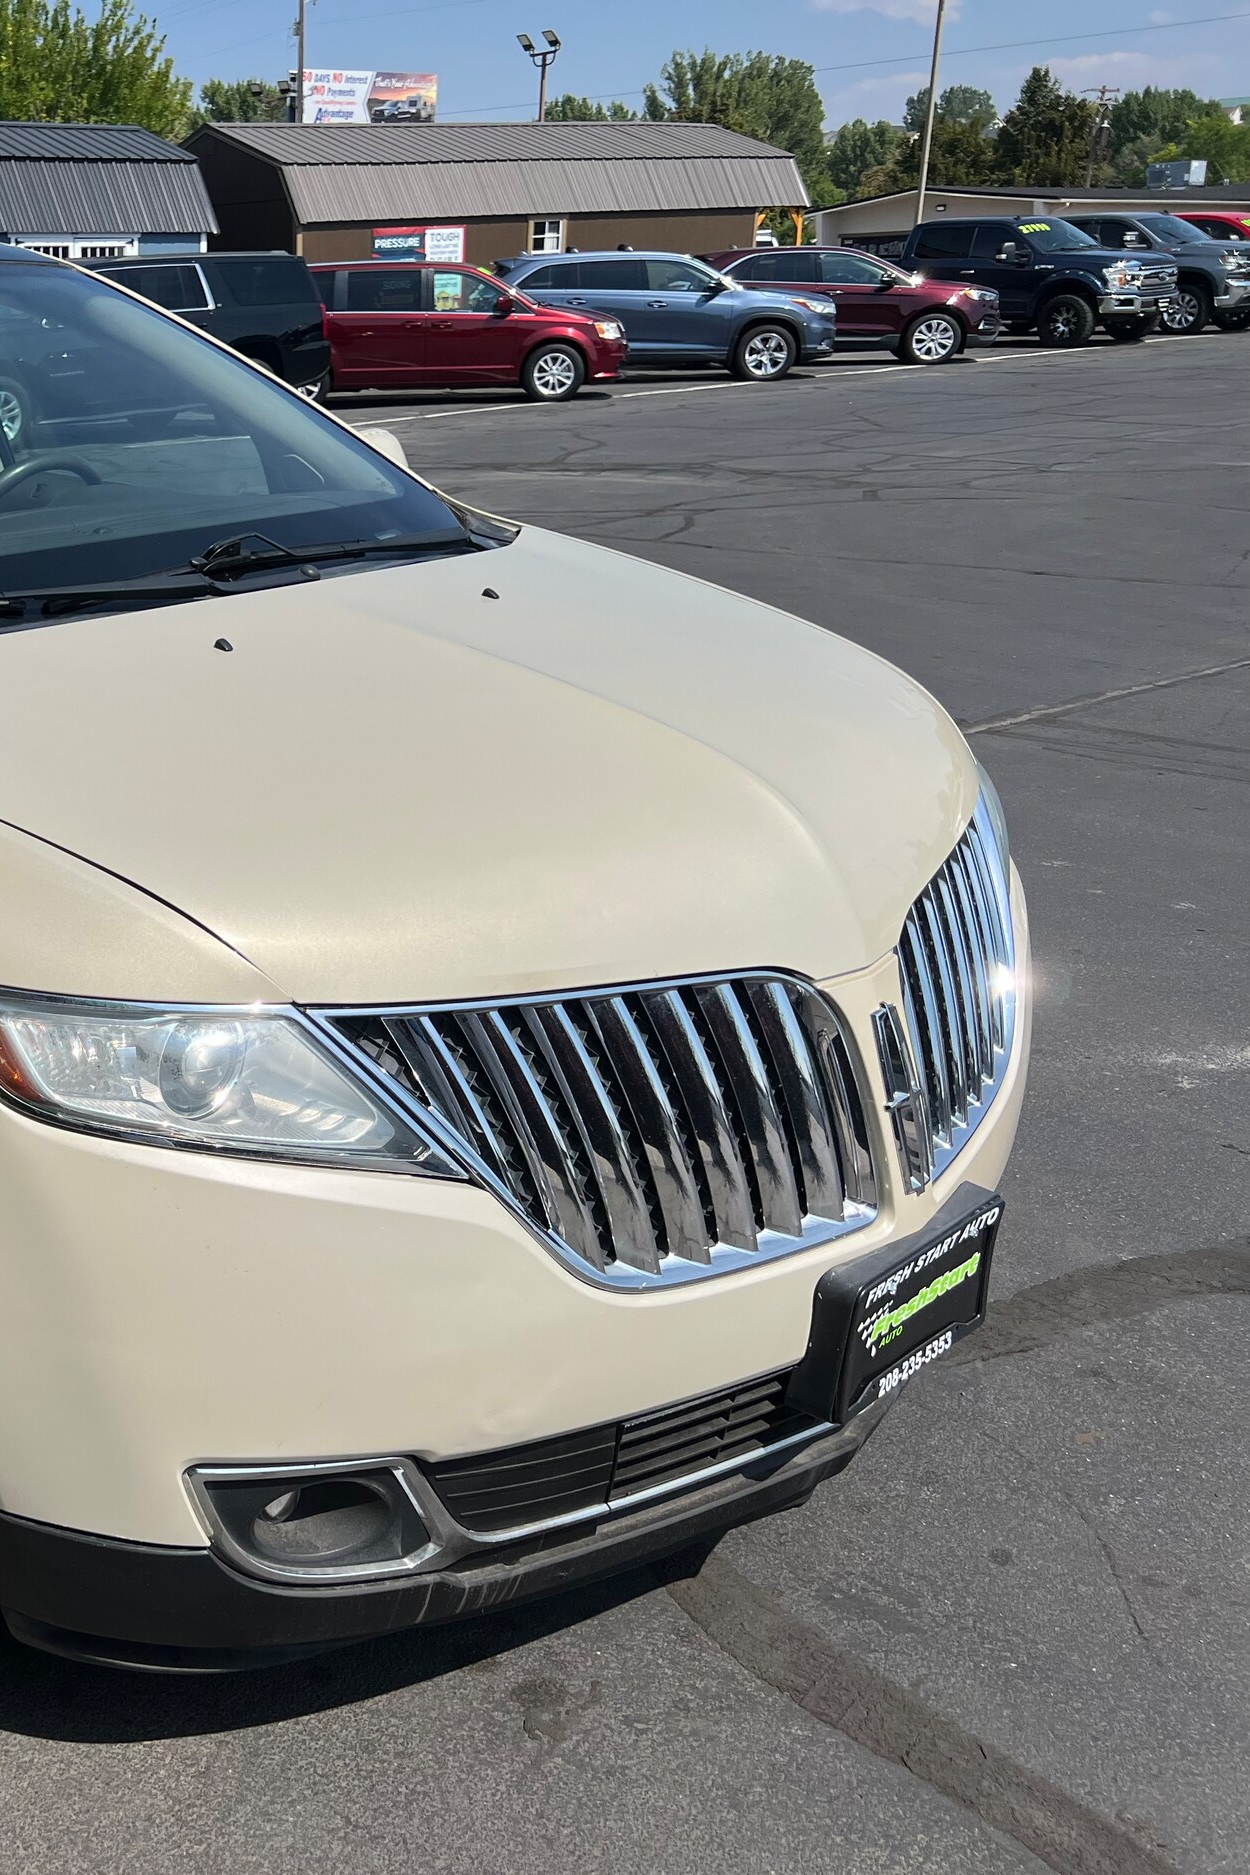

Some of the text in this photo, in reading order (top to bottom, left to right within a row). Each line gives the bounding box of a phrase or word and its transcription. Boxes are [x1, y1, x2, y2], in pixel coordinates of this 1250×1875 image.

[332, 72, 344, 84] NO
[313, 85, 326, 96] NO
[374, 237, 420, 249] PRESSURE
[430, 232, 460, 243] TOUGH
[864, 1206, 1000, 1309] FRESH START AUTO
[878, 1325, 904, 1349] AUTO
[877, 1330, 953, 1399] 208-235-5353
